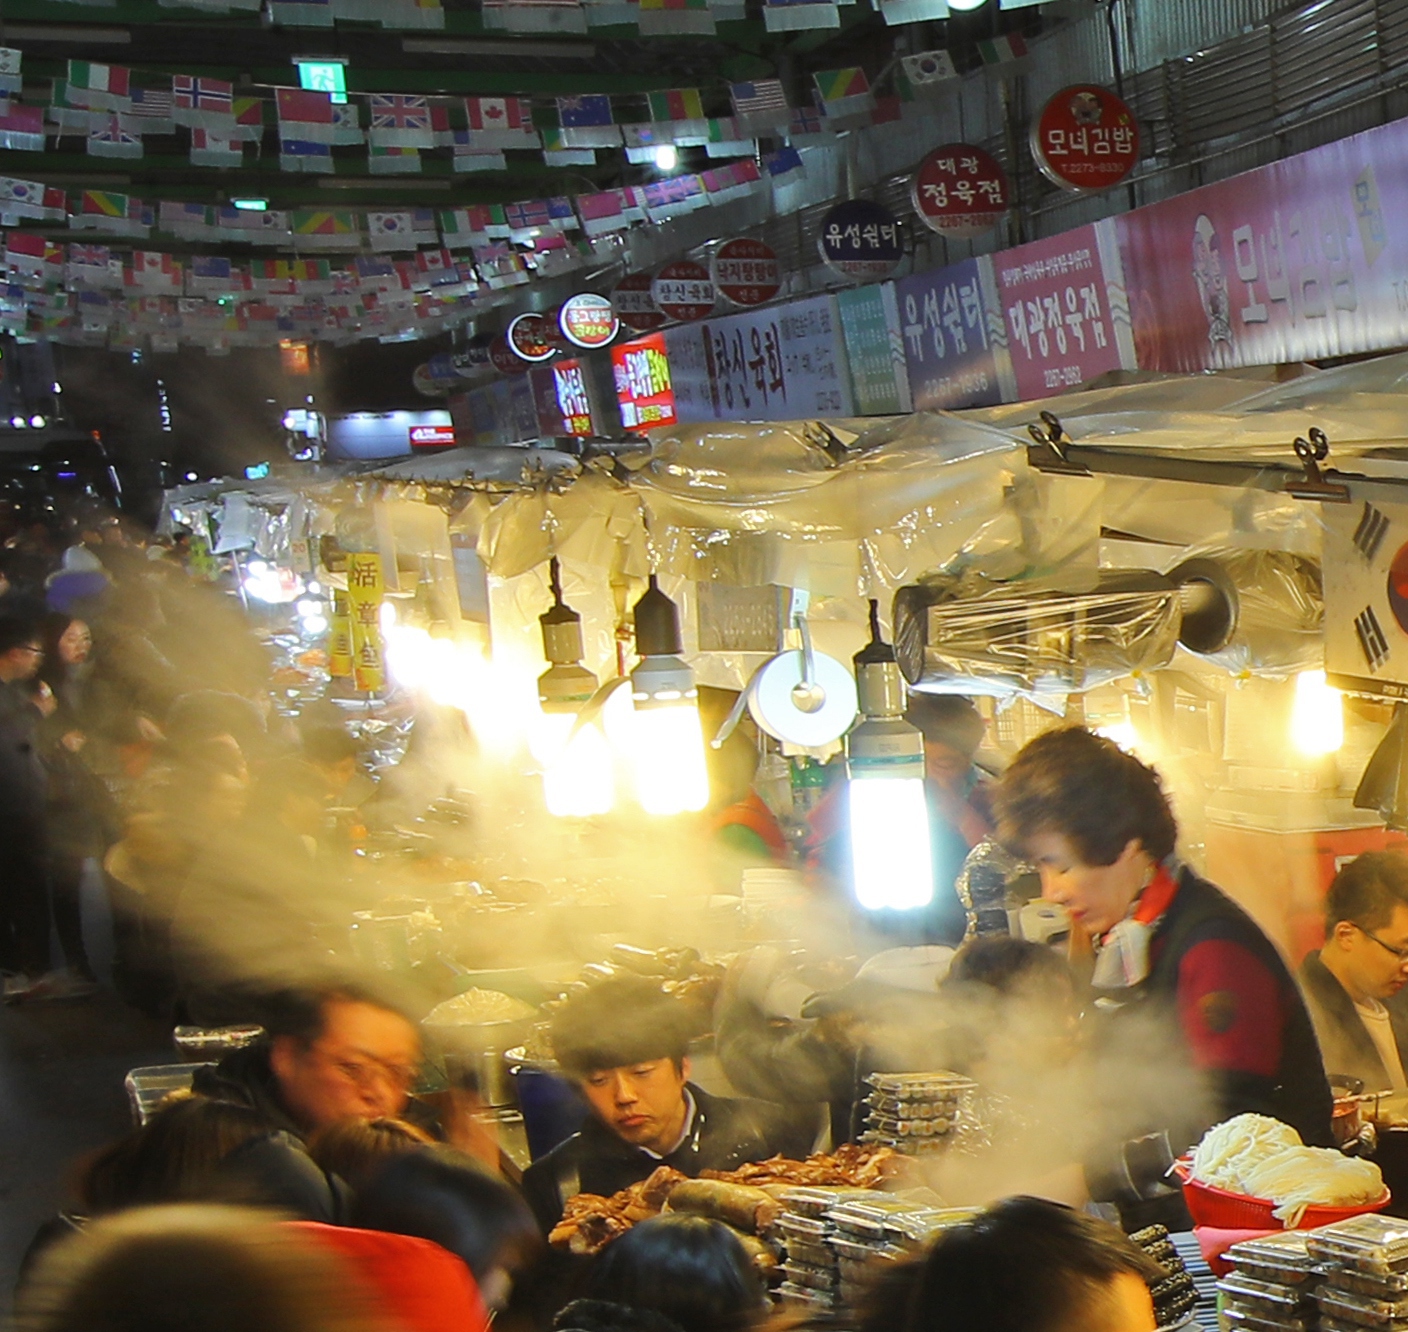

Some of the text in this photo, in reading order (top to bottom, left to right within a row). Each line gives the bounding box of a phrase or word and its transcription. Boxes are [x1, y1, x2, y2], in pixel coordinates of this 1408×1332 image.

[1048, 126, 1133, 155] 모녀김밥
[937, 156, 979, 175] 대광
[922, 180, 1003, 207] 정육점
[826, 223, 897, 249] 유성쉼터
[659, 284, 714, 302] 창신육회
[904, 277, 988, 362] 유성쉼터
[1009, 283, 1107, 360] 대광정육점
